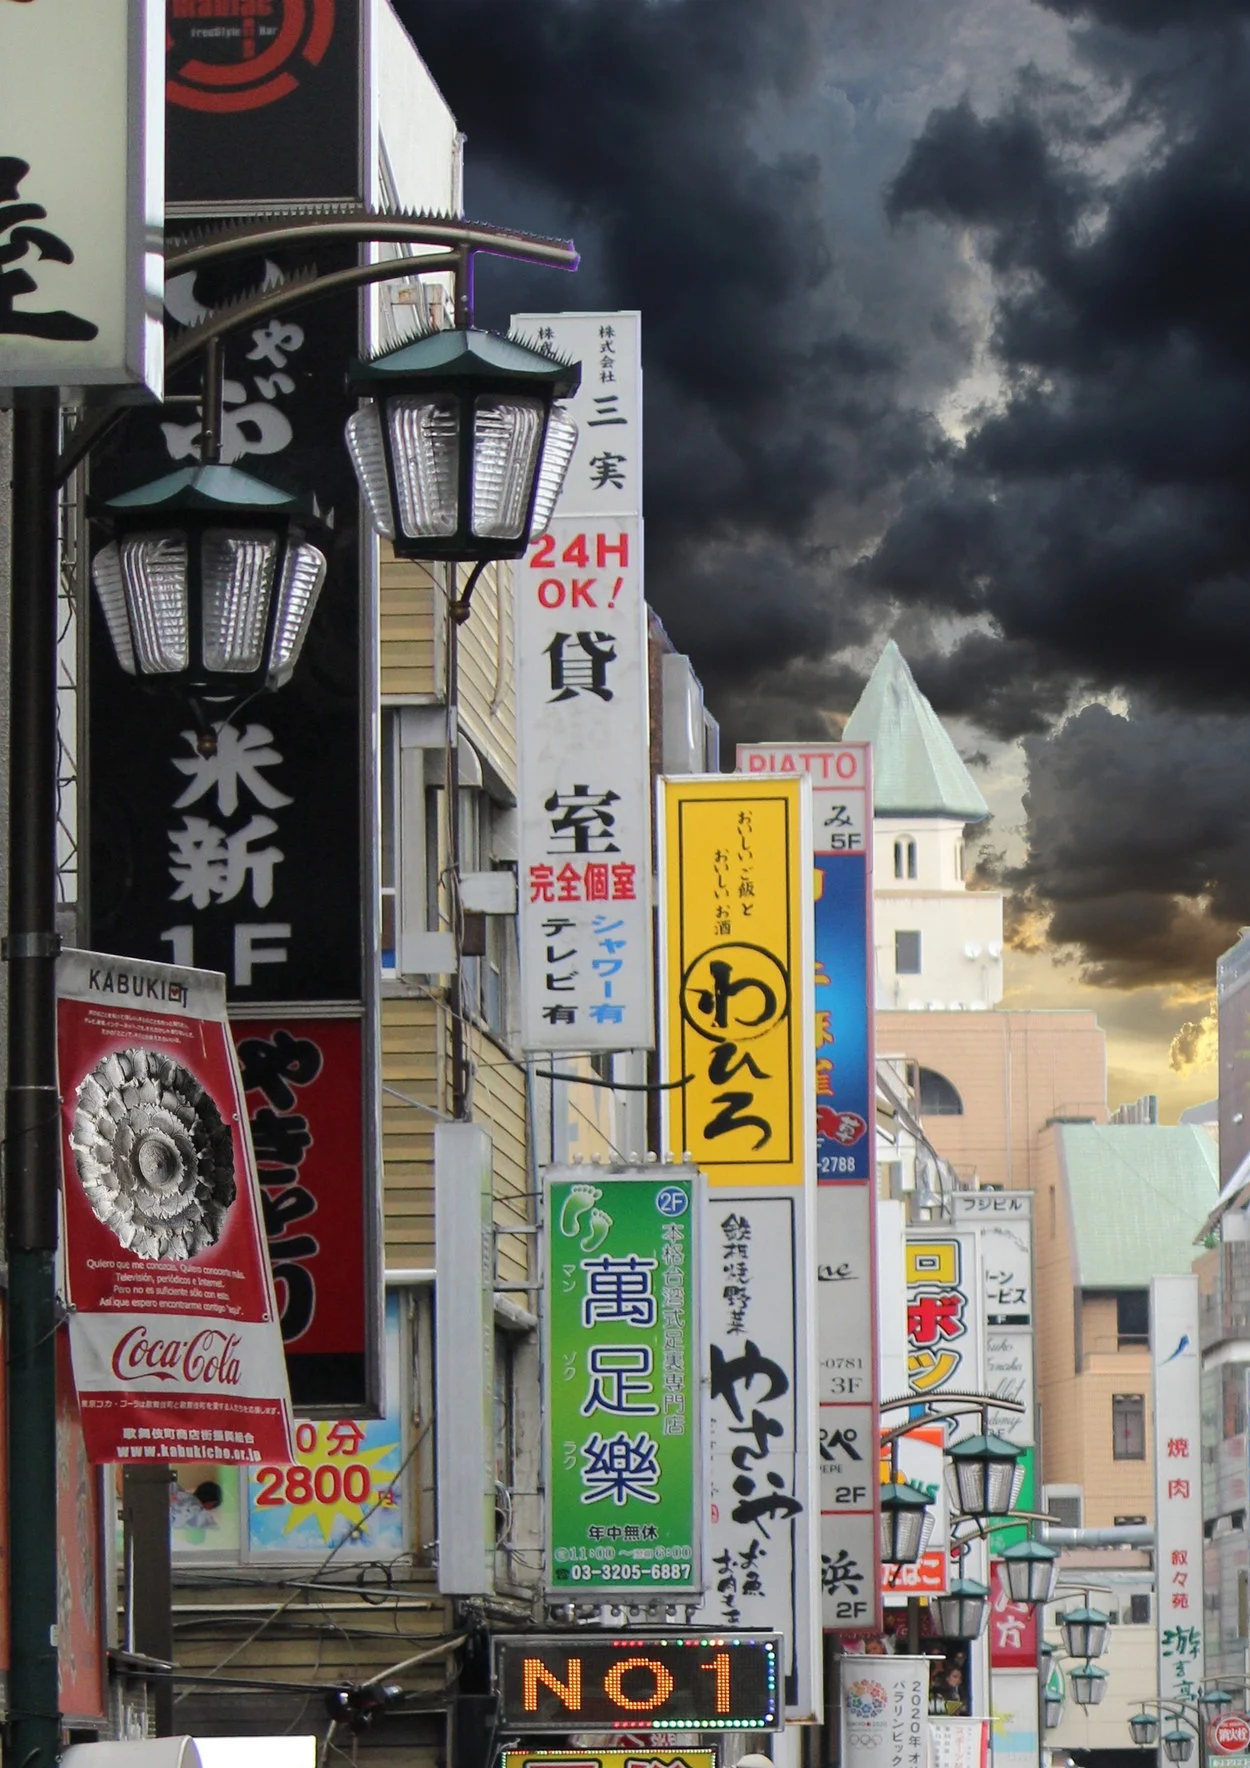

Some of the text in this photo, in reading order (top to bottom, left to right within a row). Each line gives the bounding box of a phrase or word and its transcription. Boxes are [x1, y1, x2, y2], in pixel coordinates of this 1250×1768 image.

[598, 324, 617, 384] 株式会社
[529, 532, 630, 569] 24H
[537, 577, 624, 610] OK!
[541, 631, 622, 856] 貸室
[167, 721, 295, 909] 米新
[736, 810, 756, 916] おいしいご飯と
[830, 833, 861, 850] 5F
[529, 862, 637, 903] 完全個室
[713, 850, 731, 936] おいしいお酒
[160, 923, 294, 987] 1F
[541, 917, 579, 1025] テレビ有
[589, 915, 627, 1025] シャワー有
[660, 1191, 684, 1211] 2F
[87, 1258, 115, 1269] Quiero
[116, 1262, 130, 1270] que
[132, 1262, 145, 1270] me
[661, 1222, 685, 1437] 本格台湾式足裏専門店
[112, 1325, 242, 1386] Coca-Cola
[831, 1377, 863, 1394] 3F
[116, 1443, 262, 1462] www.kabukicho.or.jp
[1167, 1437, 1190, 1500] 焼肉
[835, 1487, 867, 1504] 2F
[587, 1523, 659, 1541] 年中無休
[571, 1563, 691, 1581] 03-3205-6887
[836, 1602, 868, 1619] 2F
[522, 1653, 730, 1714] NO1
